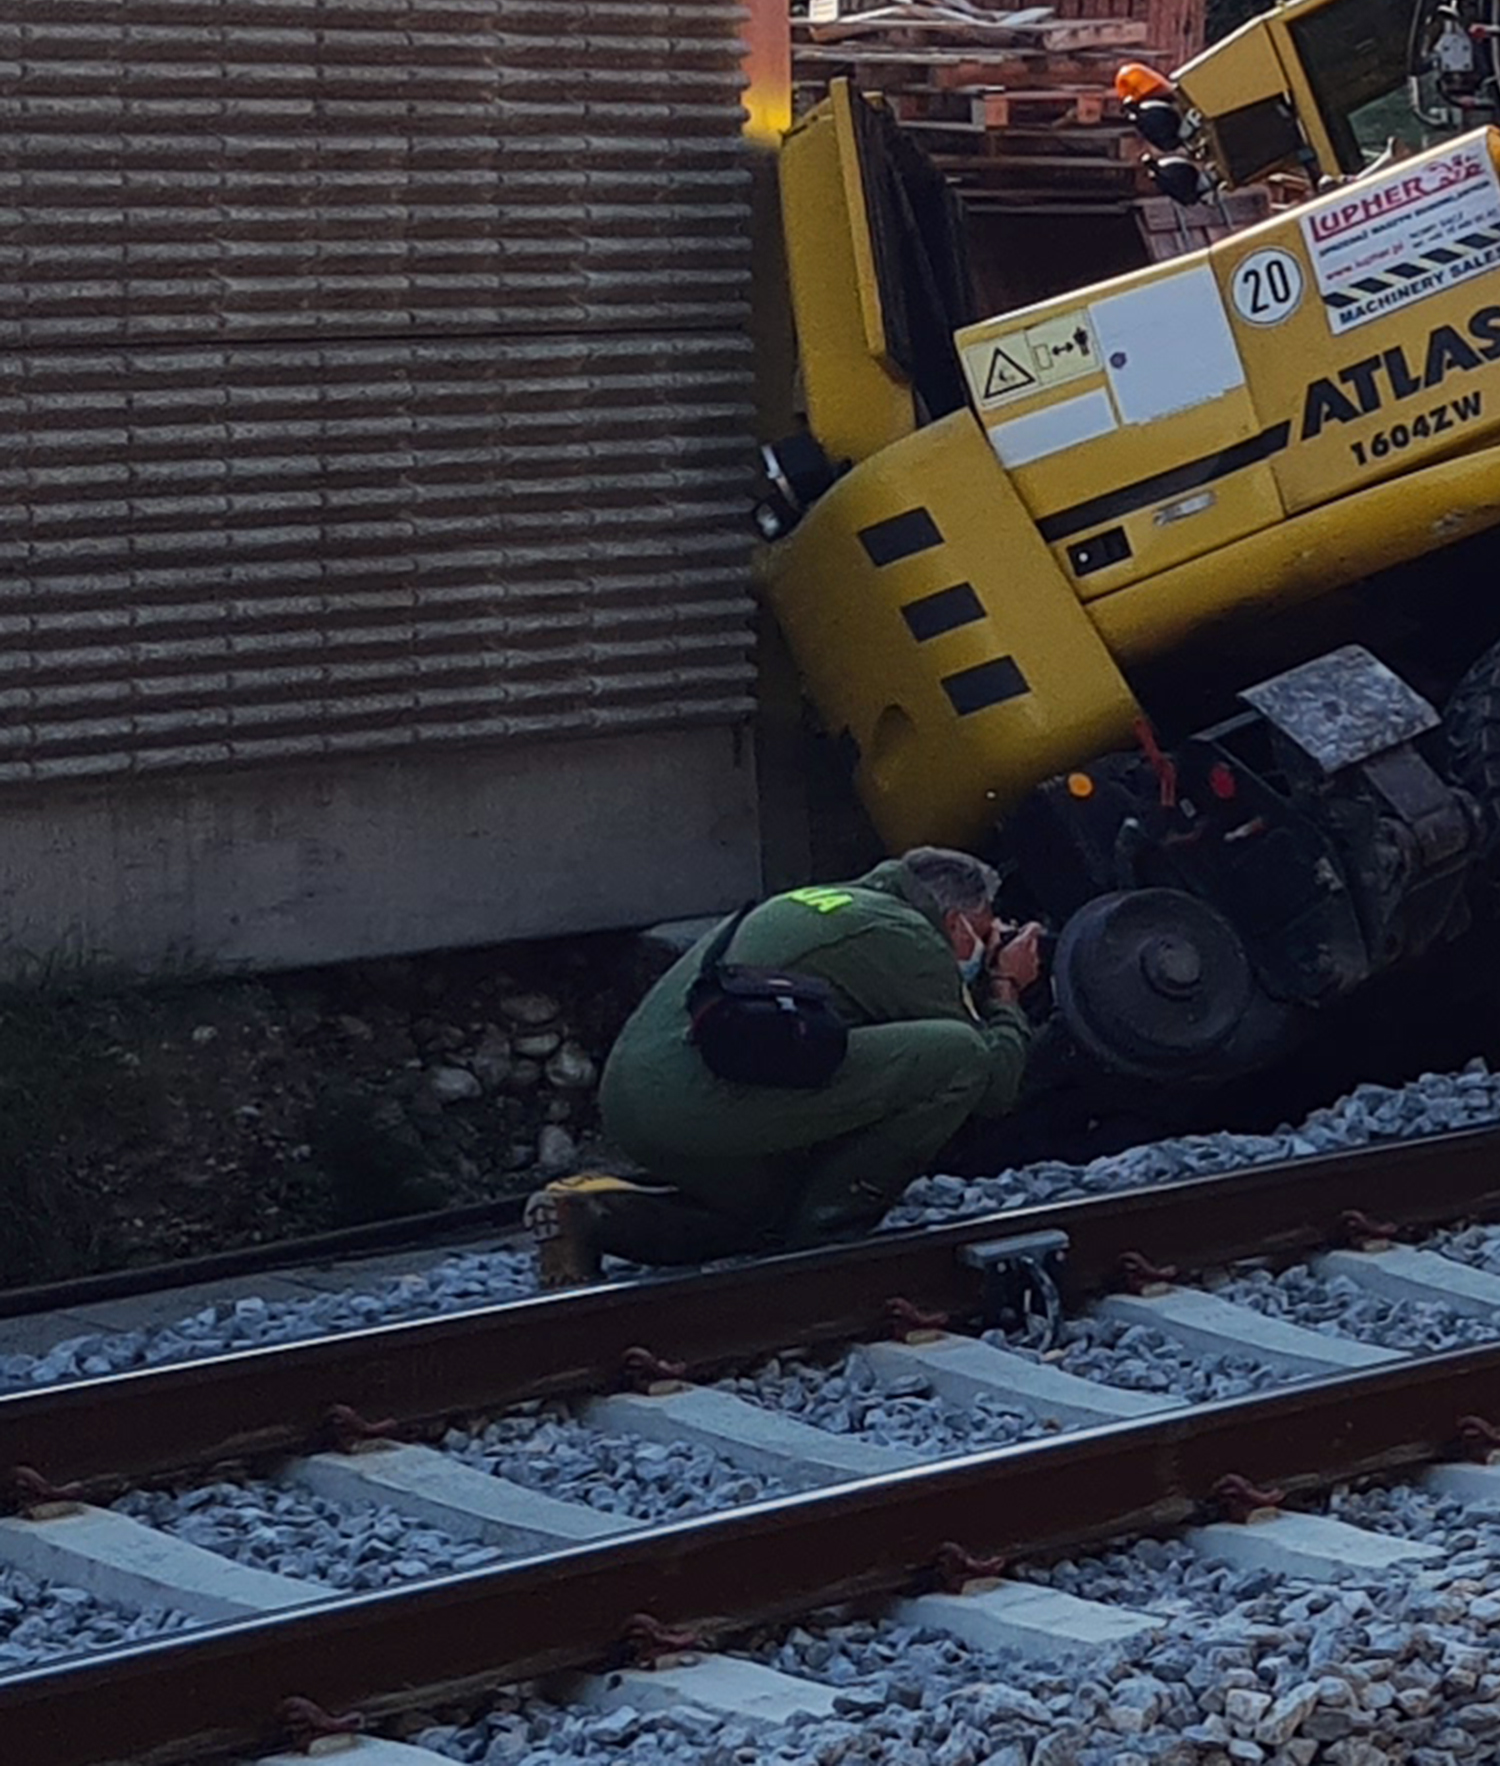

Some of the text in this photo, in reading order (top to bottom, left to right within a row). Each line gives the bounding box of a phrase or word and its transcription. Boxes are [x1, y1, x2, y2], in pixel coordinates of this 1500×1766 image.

[1242, 260, 1291, 315] 20
[1339, 271, 1445, 325] MACHINERY
[1350, 391, 1482, 466] 1604ZW
